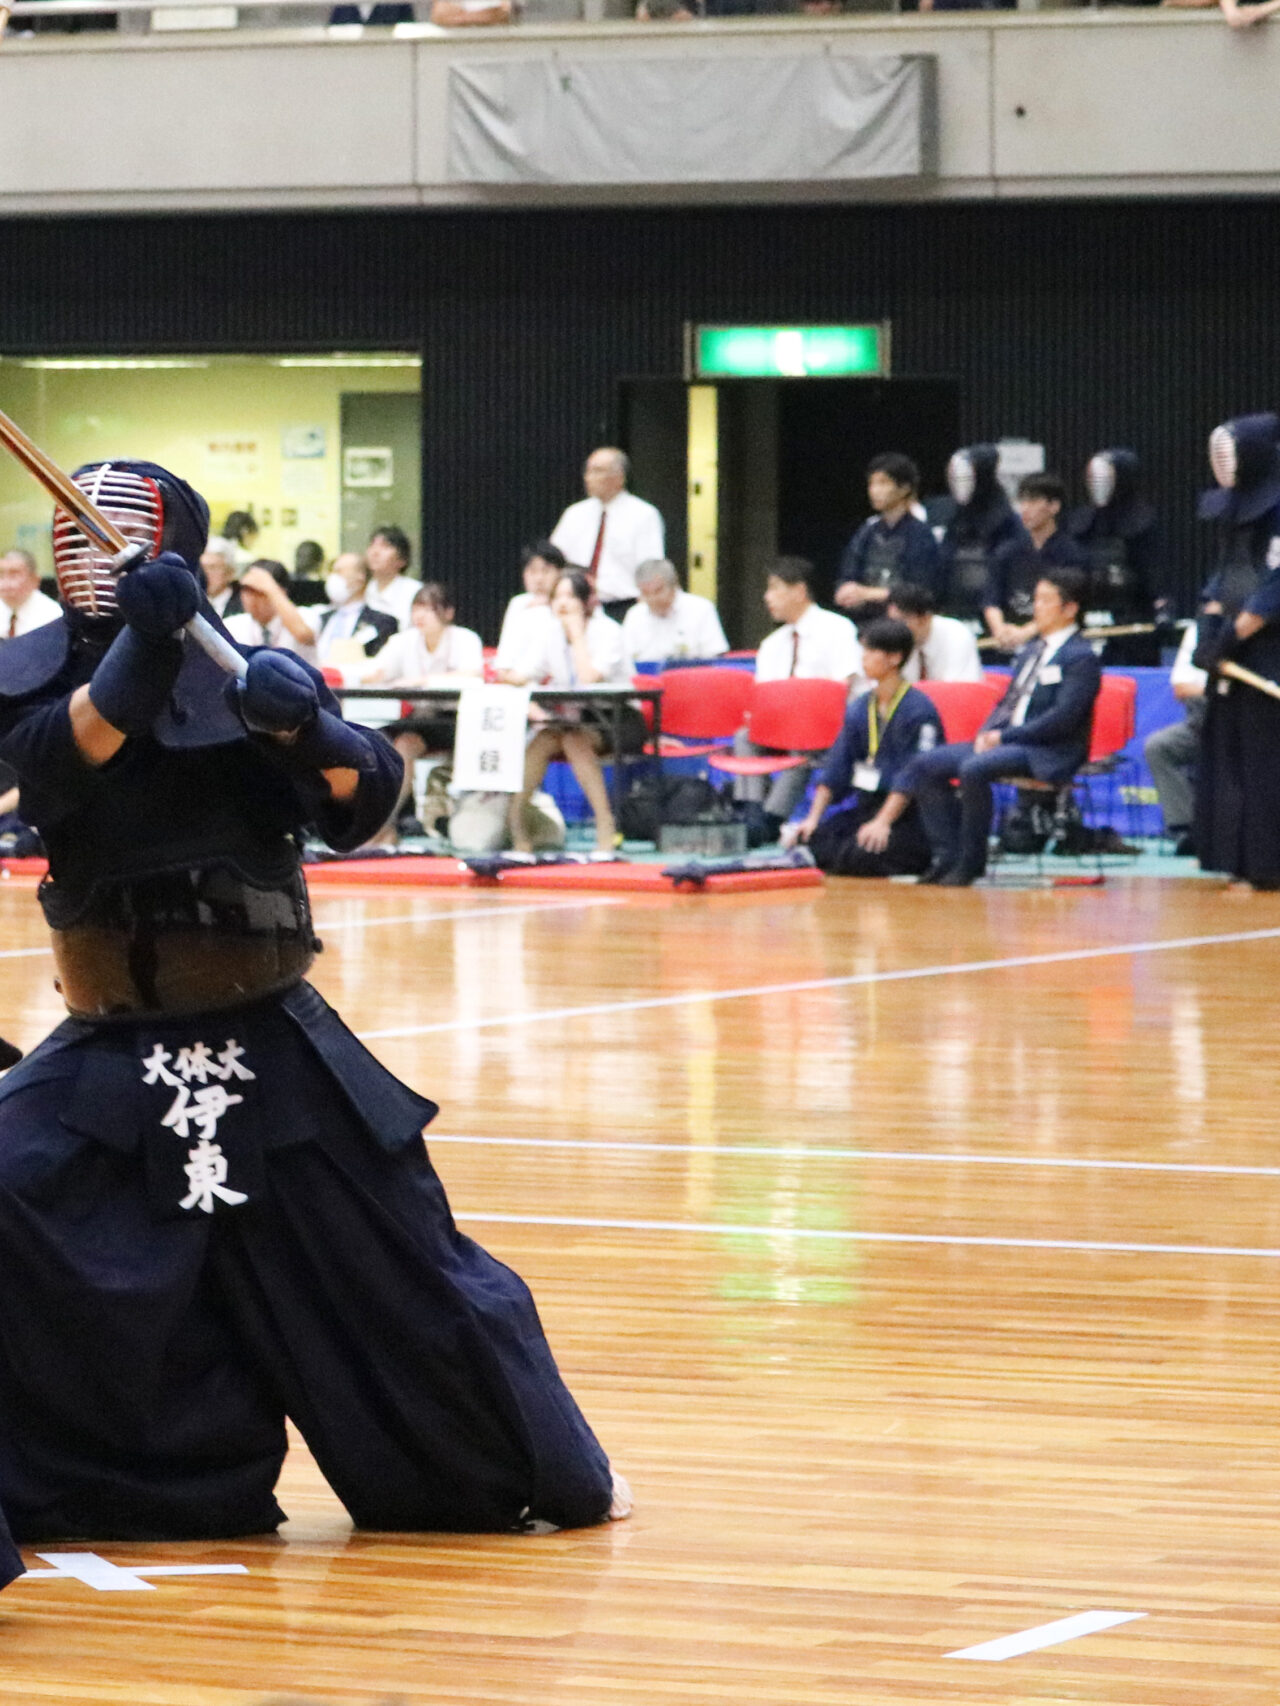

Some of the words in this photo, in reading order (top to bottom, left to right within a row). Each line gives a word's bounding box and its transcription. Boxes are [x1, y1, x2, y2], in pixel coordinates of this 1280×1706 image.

[141, 1038, 257, 1086] 大体大
[160, 1085, 248, 1214] 伊東
